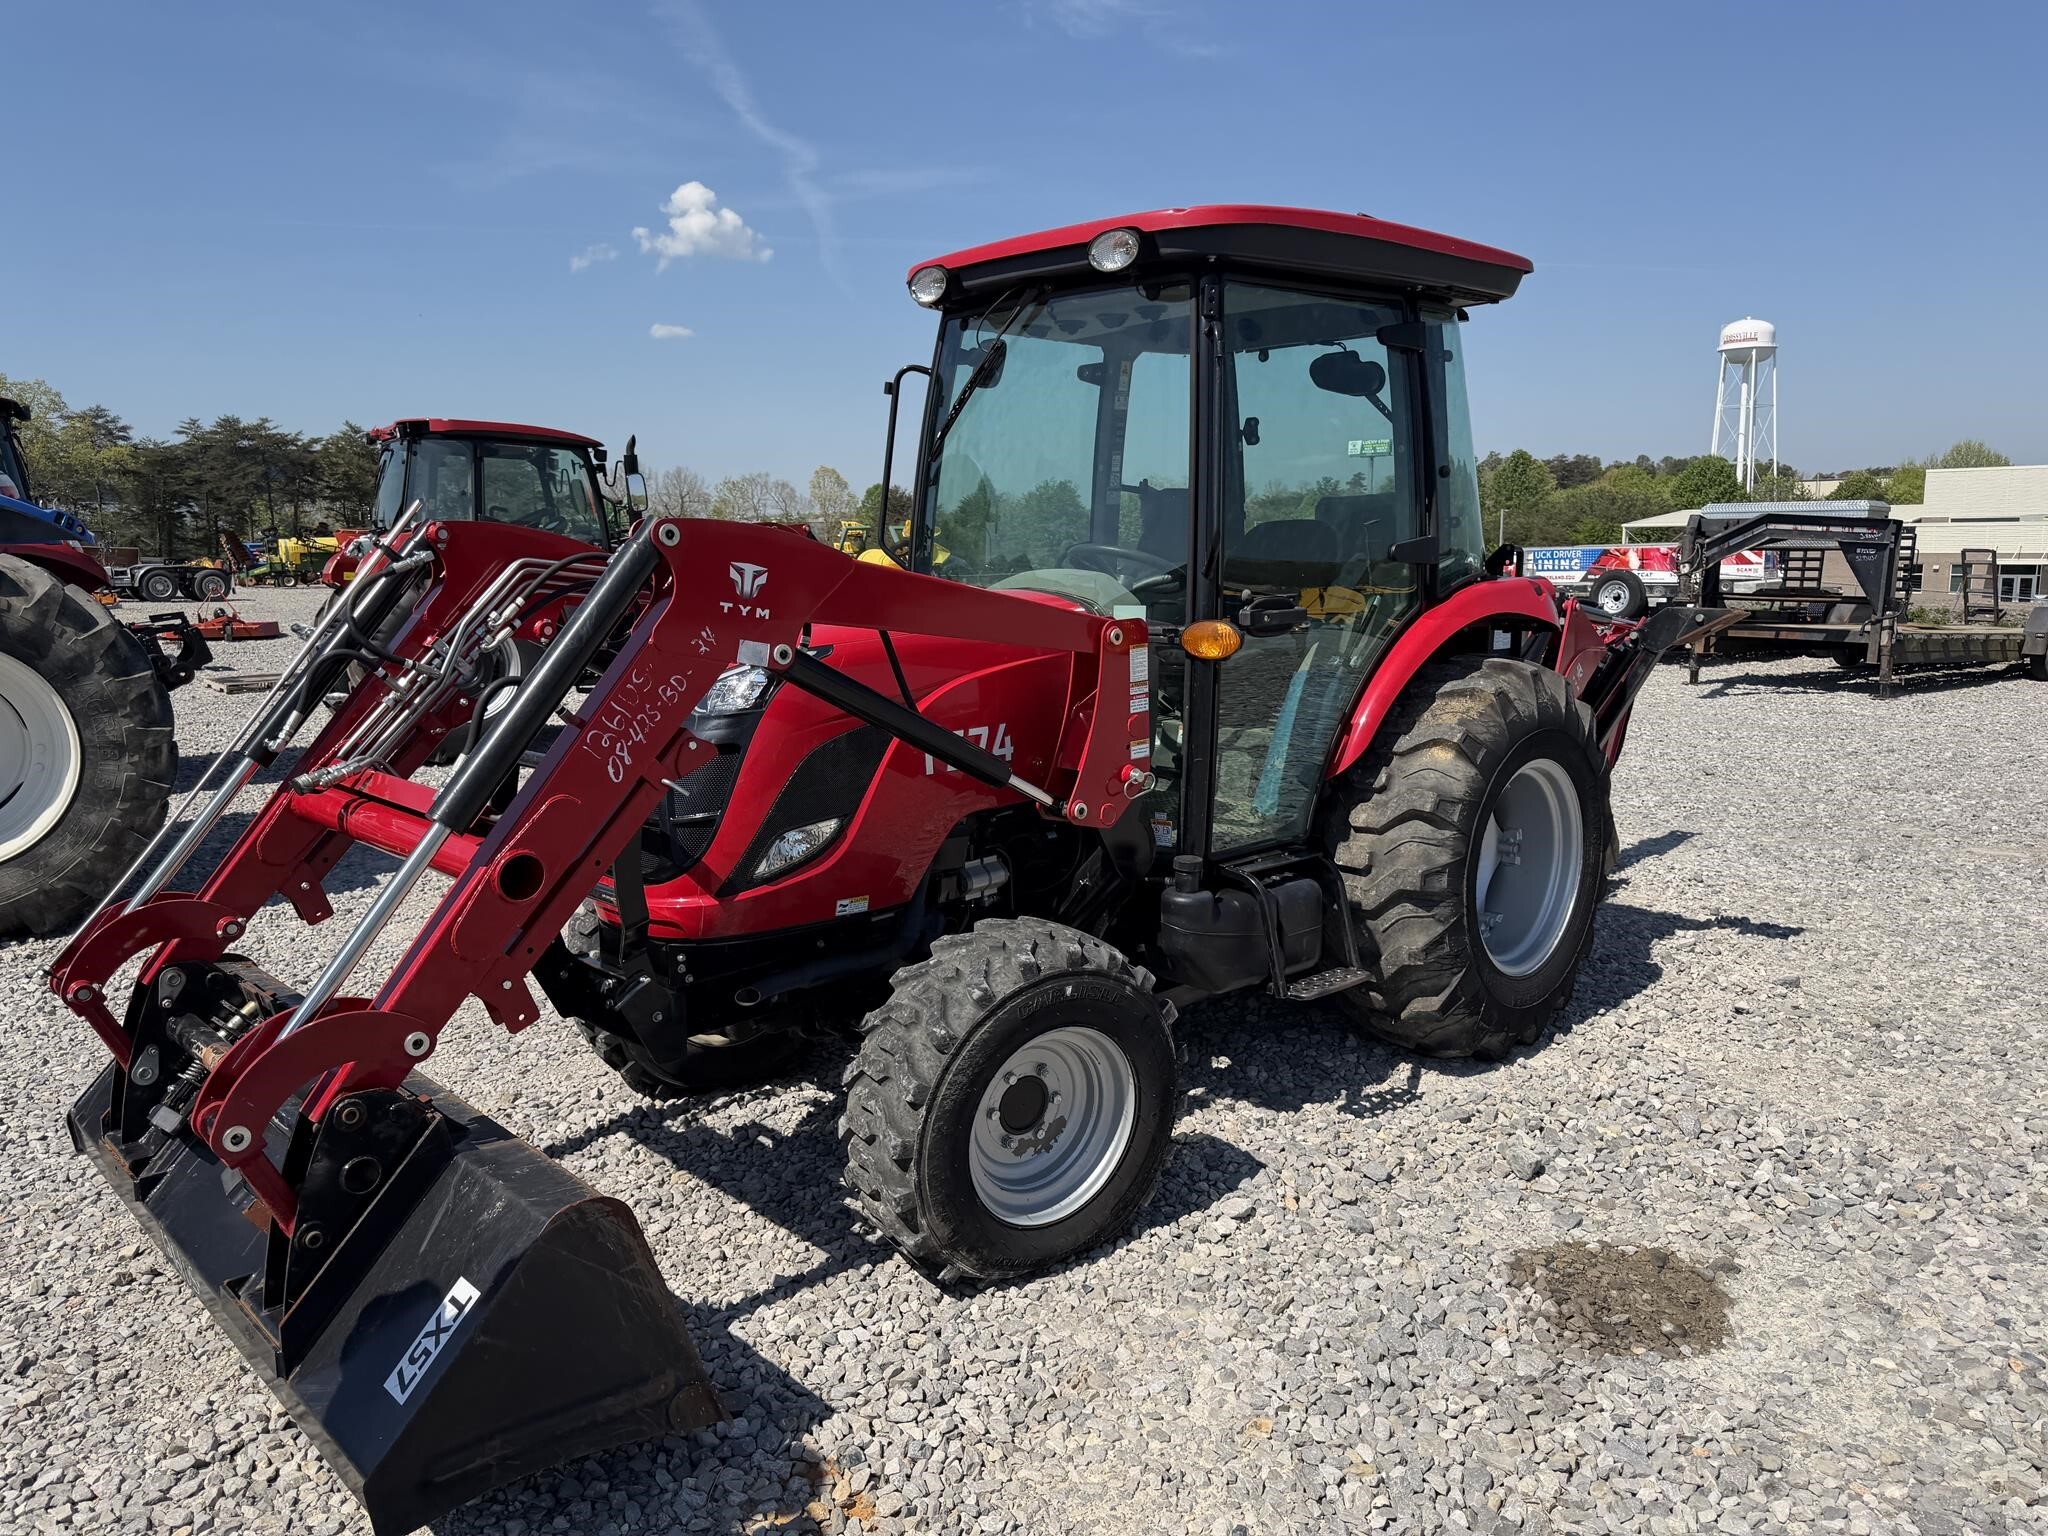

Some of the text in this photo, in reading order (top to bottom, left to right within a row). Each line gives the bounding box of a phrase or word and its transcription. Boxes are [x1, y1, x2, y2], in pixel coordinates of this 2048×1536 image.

[1553, 550, 1582, 559] DRIVER
[720, 601, 770, 620] TYM
[925, 723, 1014, 775] 74
[396, 1295, 472, 1395] TX57
